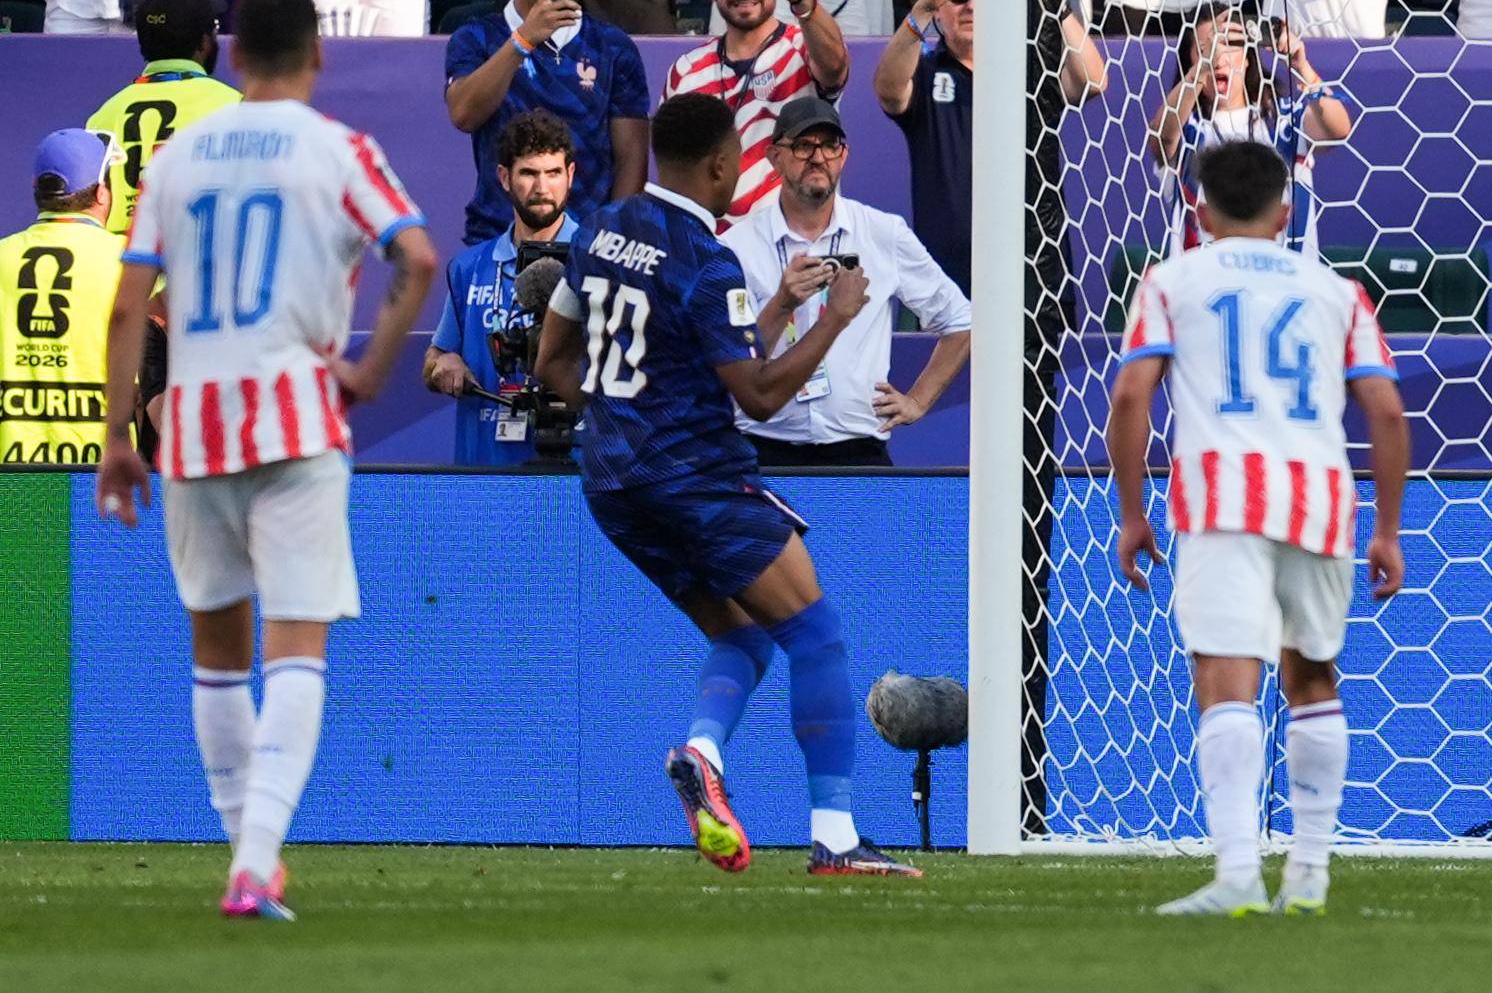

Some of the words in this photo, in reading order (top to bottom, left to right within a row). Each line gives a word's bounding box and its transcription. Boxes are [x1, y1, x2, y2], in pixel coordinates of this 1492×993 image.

[186, 190, 284, 333] 10
[30, 319, 56, 333] FIFA
[580, 276, 650, 399] 10
[15, 354, 68, 367] 2026
[16, 344, 50, 352] WORLD
[51, 344, 69, 352] CUP
[1205, 289, 1319, 423] 14
[0, 388, 107, 417] CURITY
